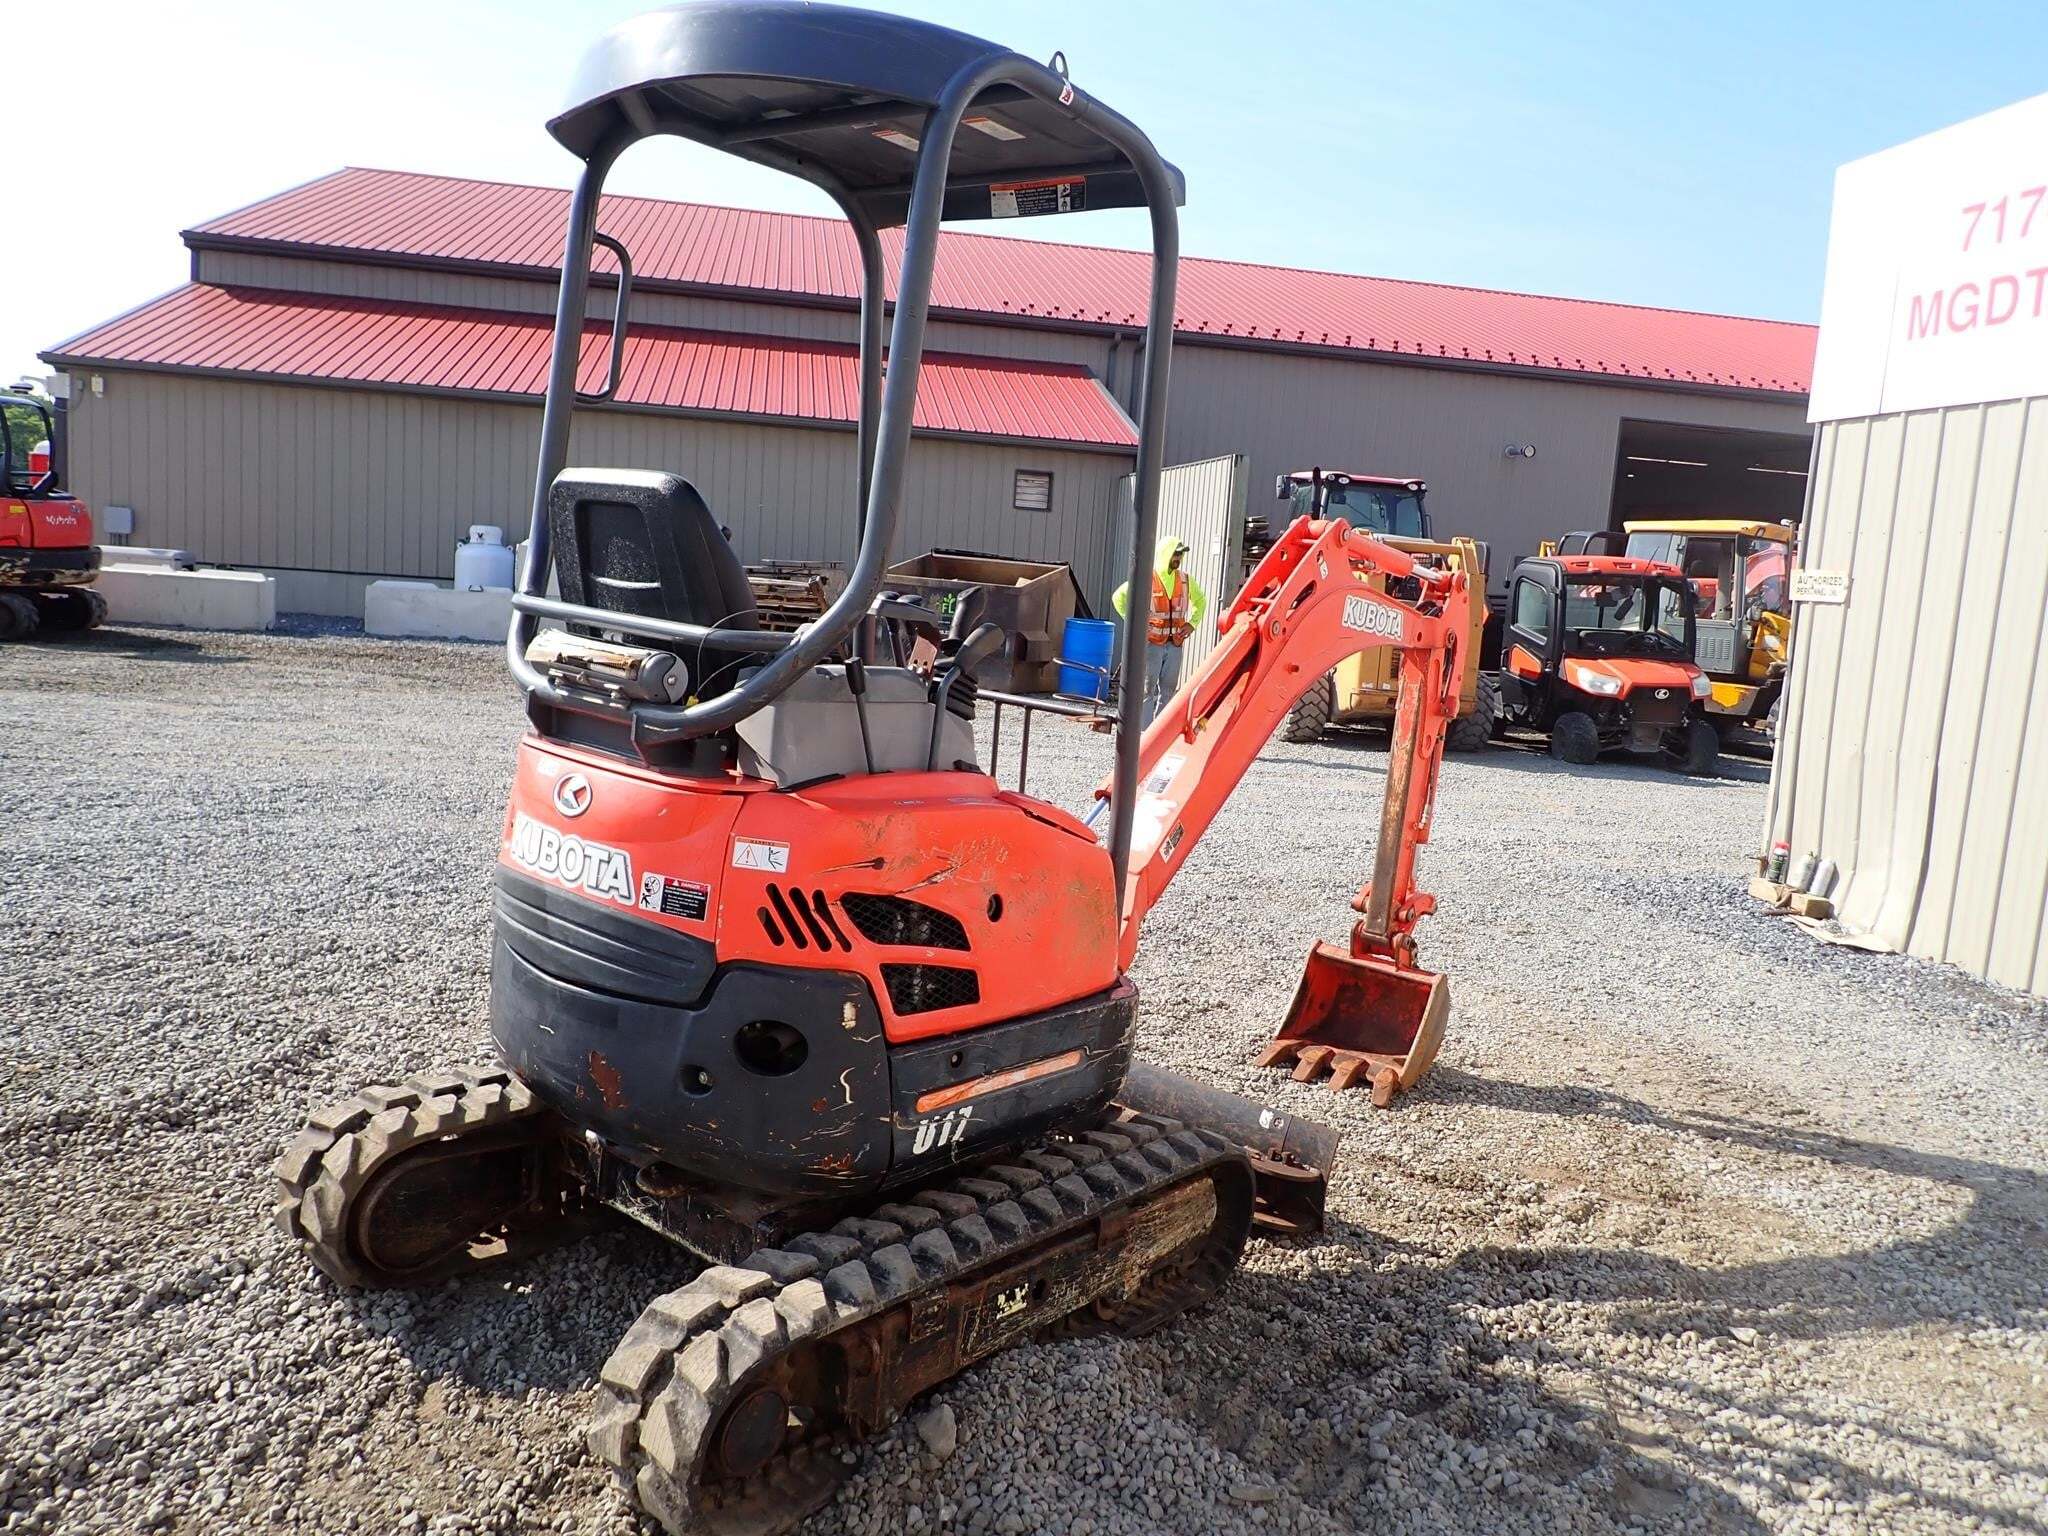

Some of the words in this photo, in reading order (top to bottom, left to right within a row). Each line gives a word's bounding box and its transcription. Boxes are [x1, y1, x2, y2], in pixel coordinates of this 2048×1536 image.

[1907, 266, 2048, 341] MGDT
[1343, 596, 1403, 638] KUBOTA
[511, 815, 634, 902] KUBOTA
